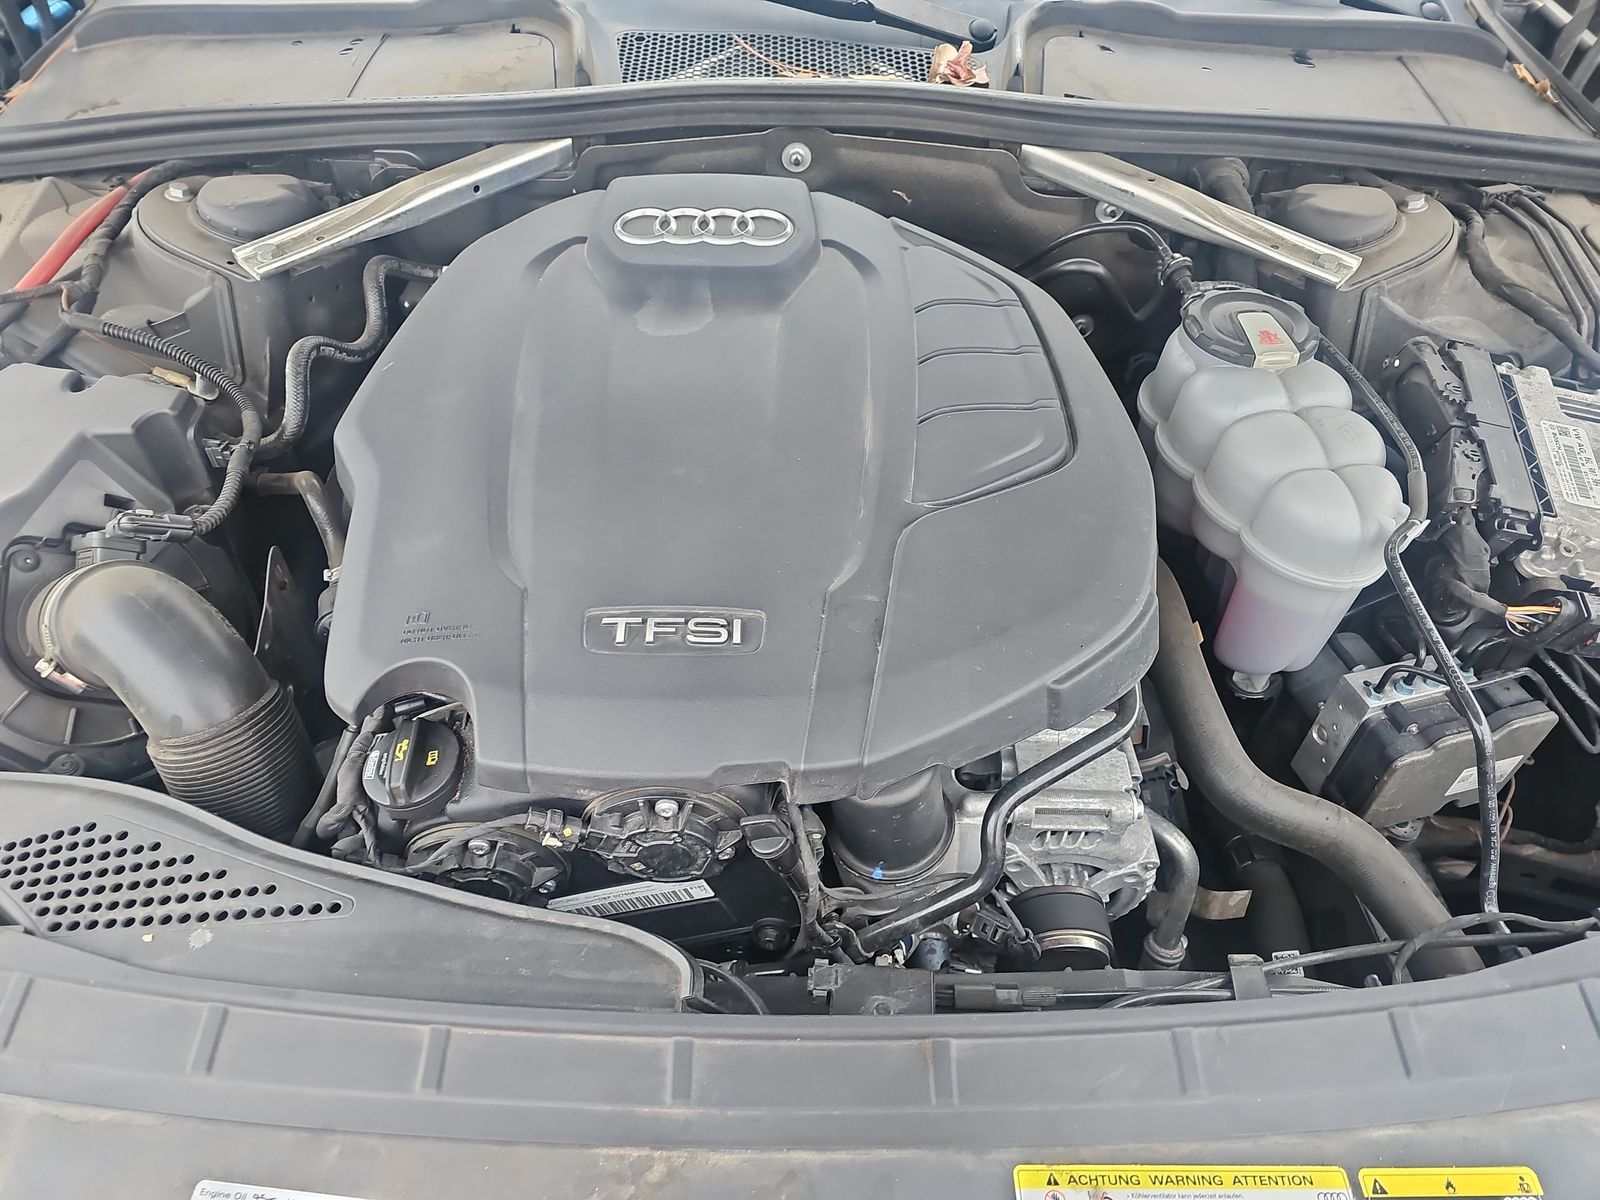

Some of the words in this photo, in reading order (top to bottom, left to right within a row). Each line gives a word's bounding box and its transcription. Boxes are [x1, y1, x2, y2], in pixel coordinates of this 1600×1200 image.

[600, 616, 742, 646] TFSI
[1067, 1174, 1141, 1186] ACHTUNG
[1148, 1174, 1224, 1186] WARNING
[1232, 1174, 1314, 1186] ATTENTION
[199, 1187, 232, 1199] Engine
[233, 1191, 248, 1200] Oil
